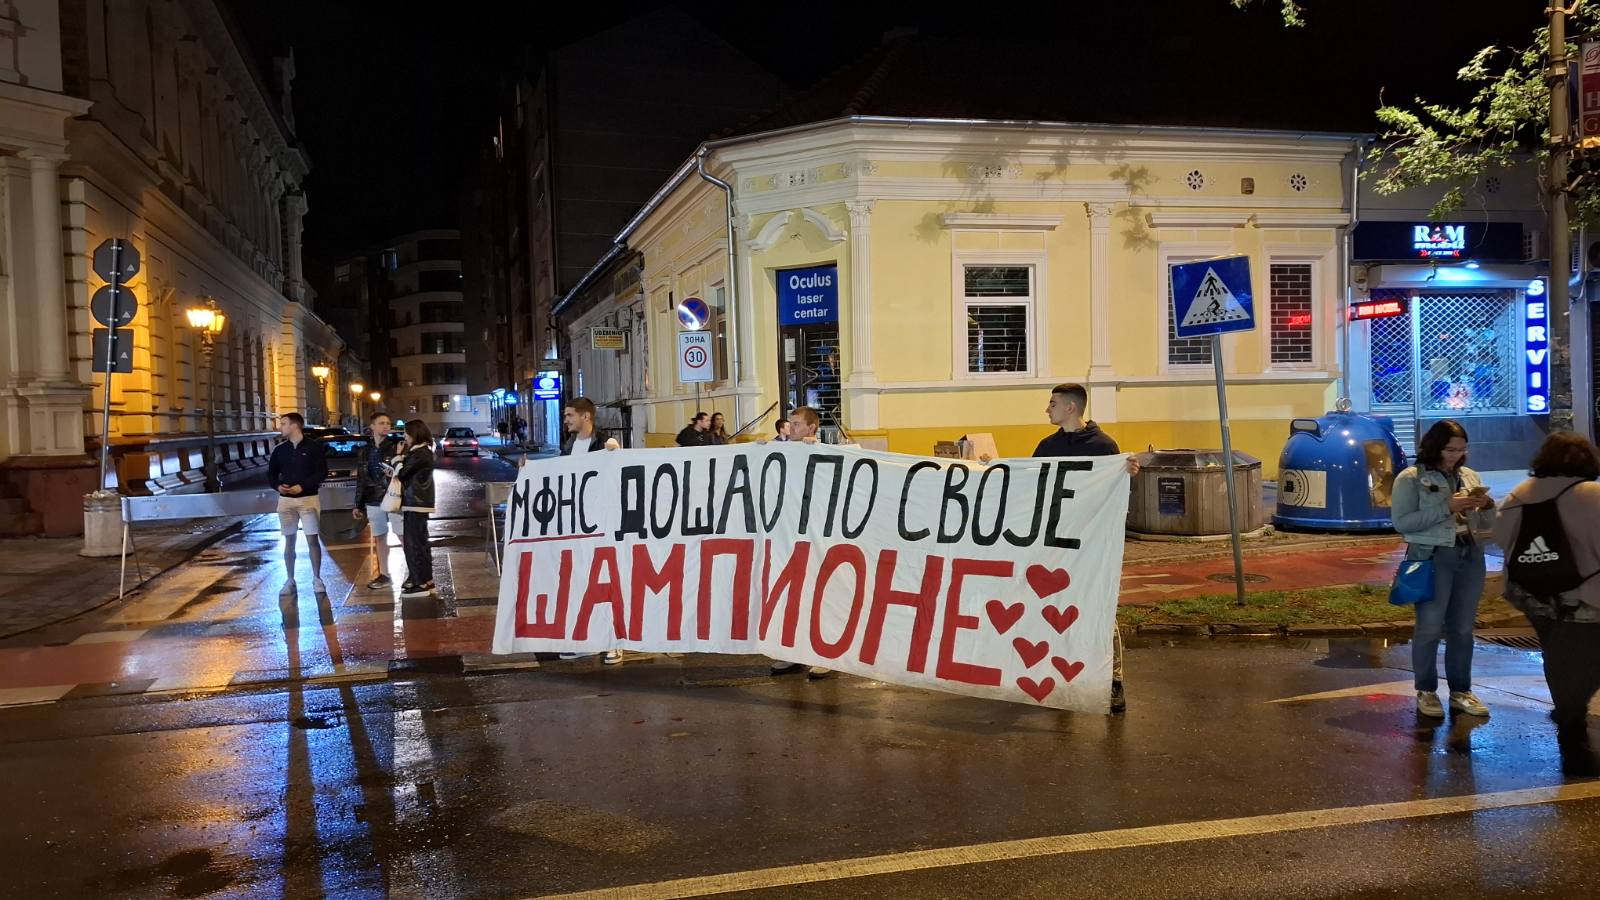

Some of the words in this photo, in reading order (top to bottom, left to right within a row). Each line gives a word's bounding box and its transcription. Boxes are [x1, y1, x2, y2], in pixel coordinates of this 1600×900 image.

[789, 273, 832, 289] Oculus
[797, 294, 824, 304] laser
[794, 308, 829, 319] centar
[684, 336, 706, 344] ЗОНА
[1526, 279, 1546, 411] SERVIS
[688, 350, 703, 363] 30
[509, 470, 599, 540] МФНС
[614, 451, 787, 542] ДОШАО
[798, 453, 879, 539] ПО
[897, 460, 1094, 550] СВОЈЕ
[514, 538, 1014, 687] ШАМПИОНЕ
